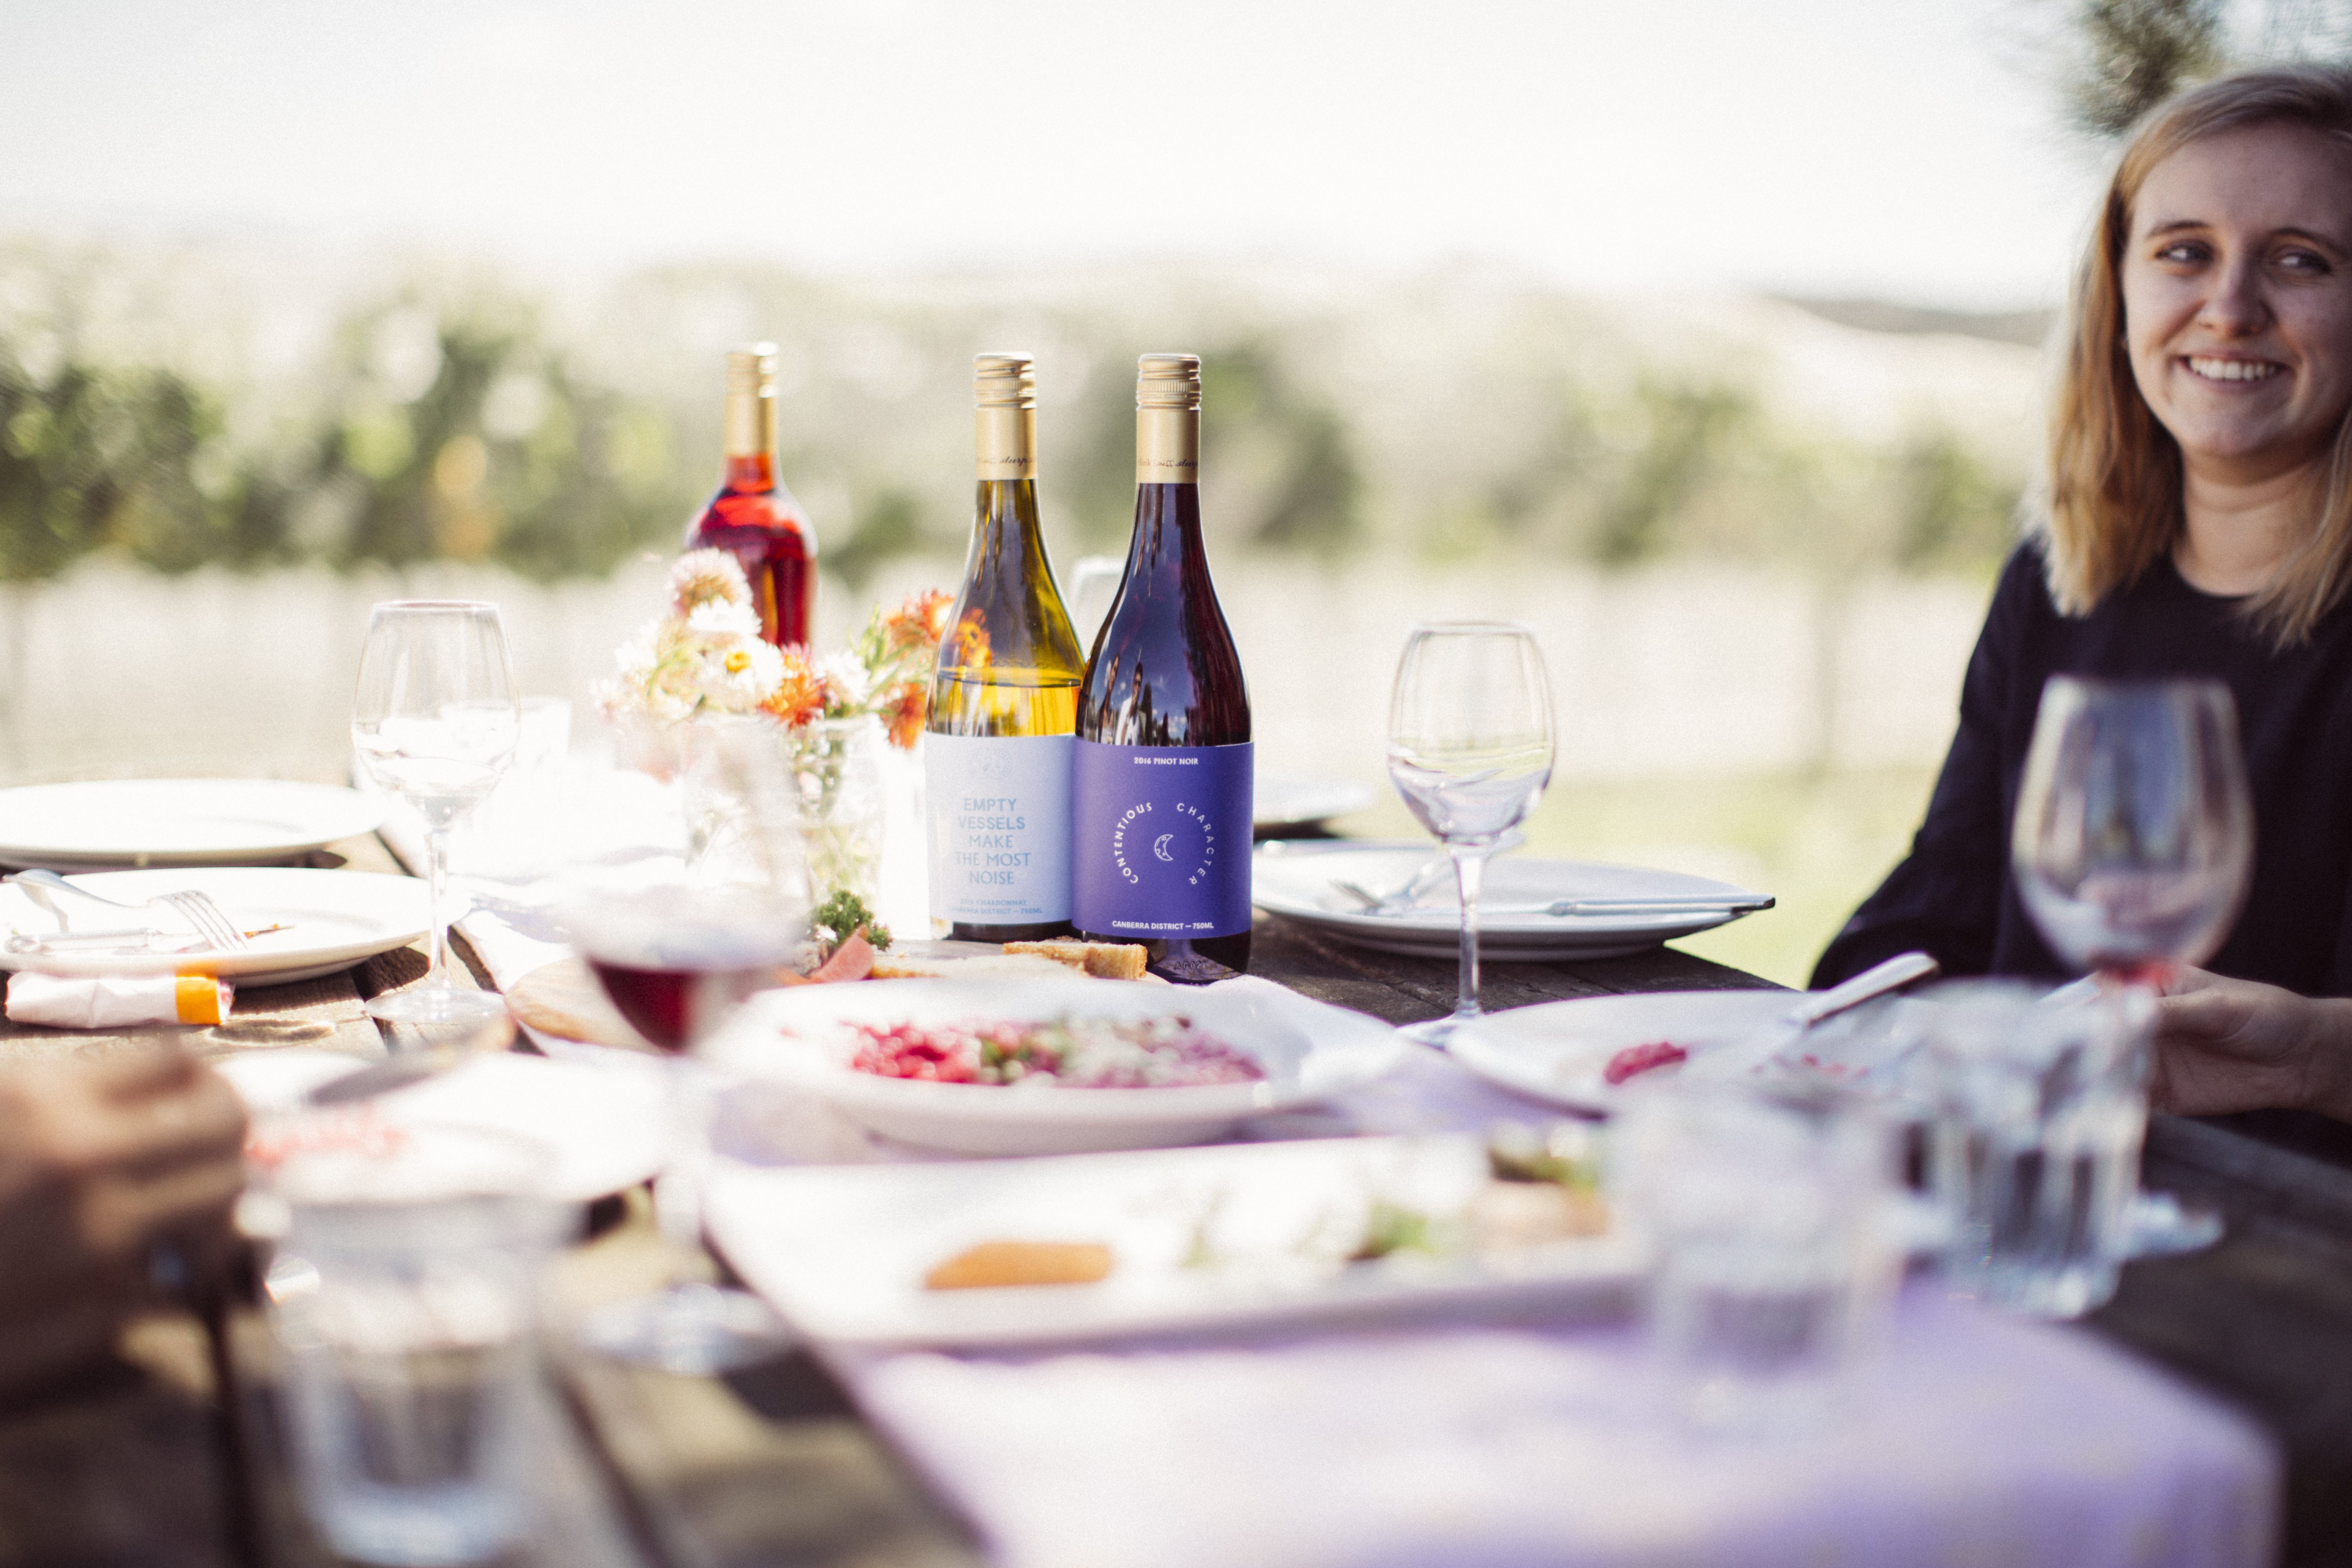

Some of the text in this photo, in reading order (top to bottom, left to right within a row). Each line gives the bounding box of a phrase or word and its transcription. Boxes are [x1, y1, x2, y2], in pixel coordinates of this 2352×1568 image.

[964, 798, 1017, 811] EMPTY
[959, 816, 1025, 829] VESSELS
[969, 835, 1013, 848] MAKE
[1114, 802, 1214, 884] CONTENTIOUS CHARACTER
[955, 852, 1031, 866] THE MOST
[969, 871, 1014, 884] NOISE
[1112, 920, 1149, 929] CANBERRA
